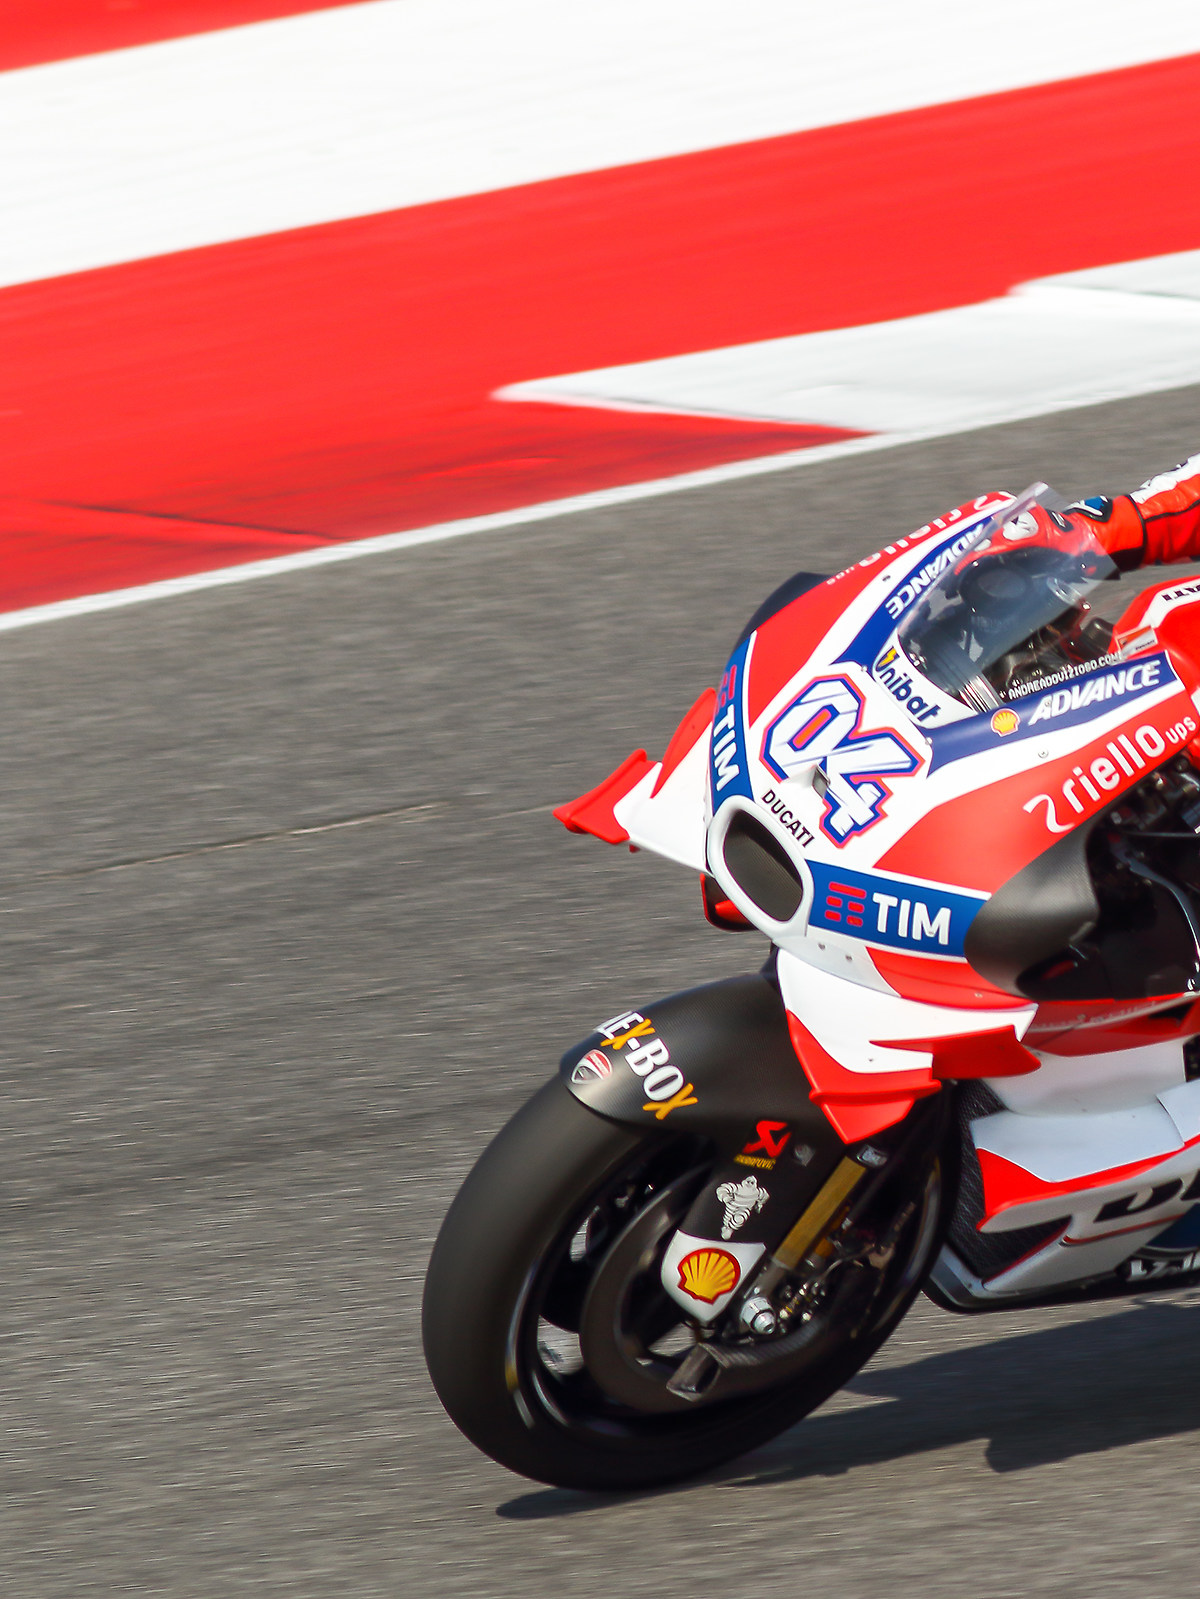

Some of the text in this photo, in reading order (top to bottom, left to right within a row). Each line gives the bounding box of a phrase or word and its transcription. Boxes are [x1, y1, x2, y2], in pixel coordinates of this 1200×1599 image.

[1028, 660, 1162, 726] ADVANCE
[712, 703, 741, 792] TIM
[759, 673, 926, 849] 04
[1062, 716, 1198, 815] riello ups
[761, 789, 816, 848] DUCATI
[872, 891, 952, 946] TIM
